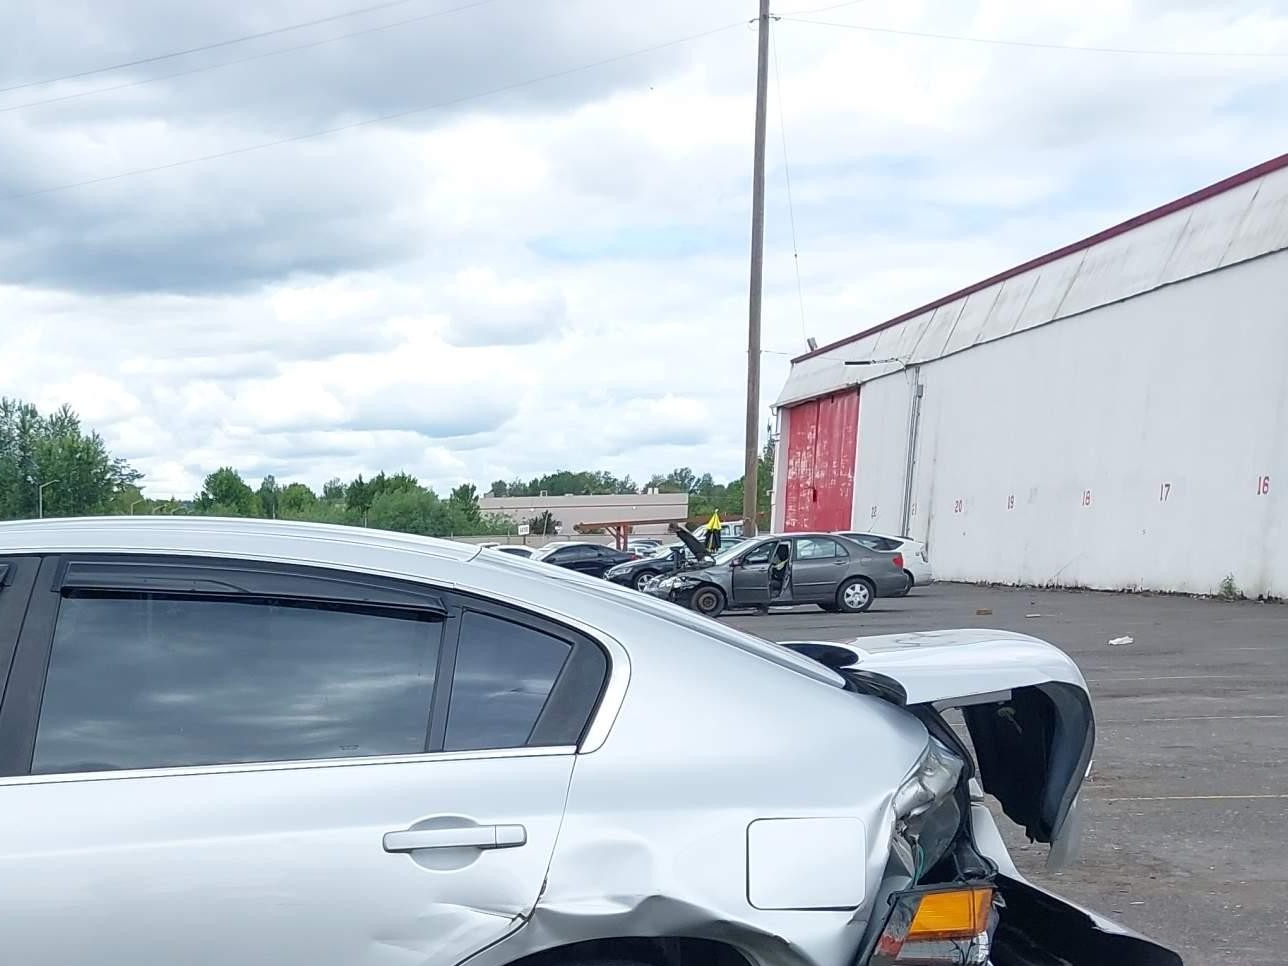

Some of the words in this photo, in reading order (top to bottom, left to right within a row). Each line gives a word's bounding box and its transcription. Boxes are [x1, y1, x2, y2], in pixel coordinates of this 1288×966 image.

[1159, 483, 1171, 502] 17
[1257, 475, 1270, 496] 16
[954, 499, 963, 513] 20
[1007, 495, 1015, 510] 19
[1082, 490, 1091, 507] 18
